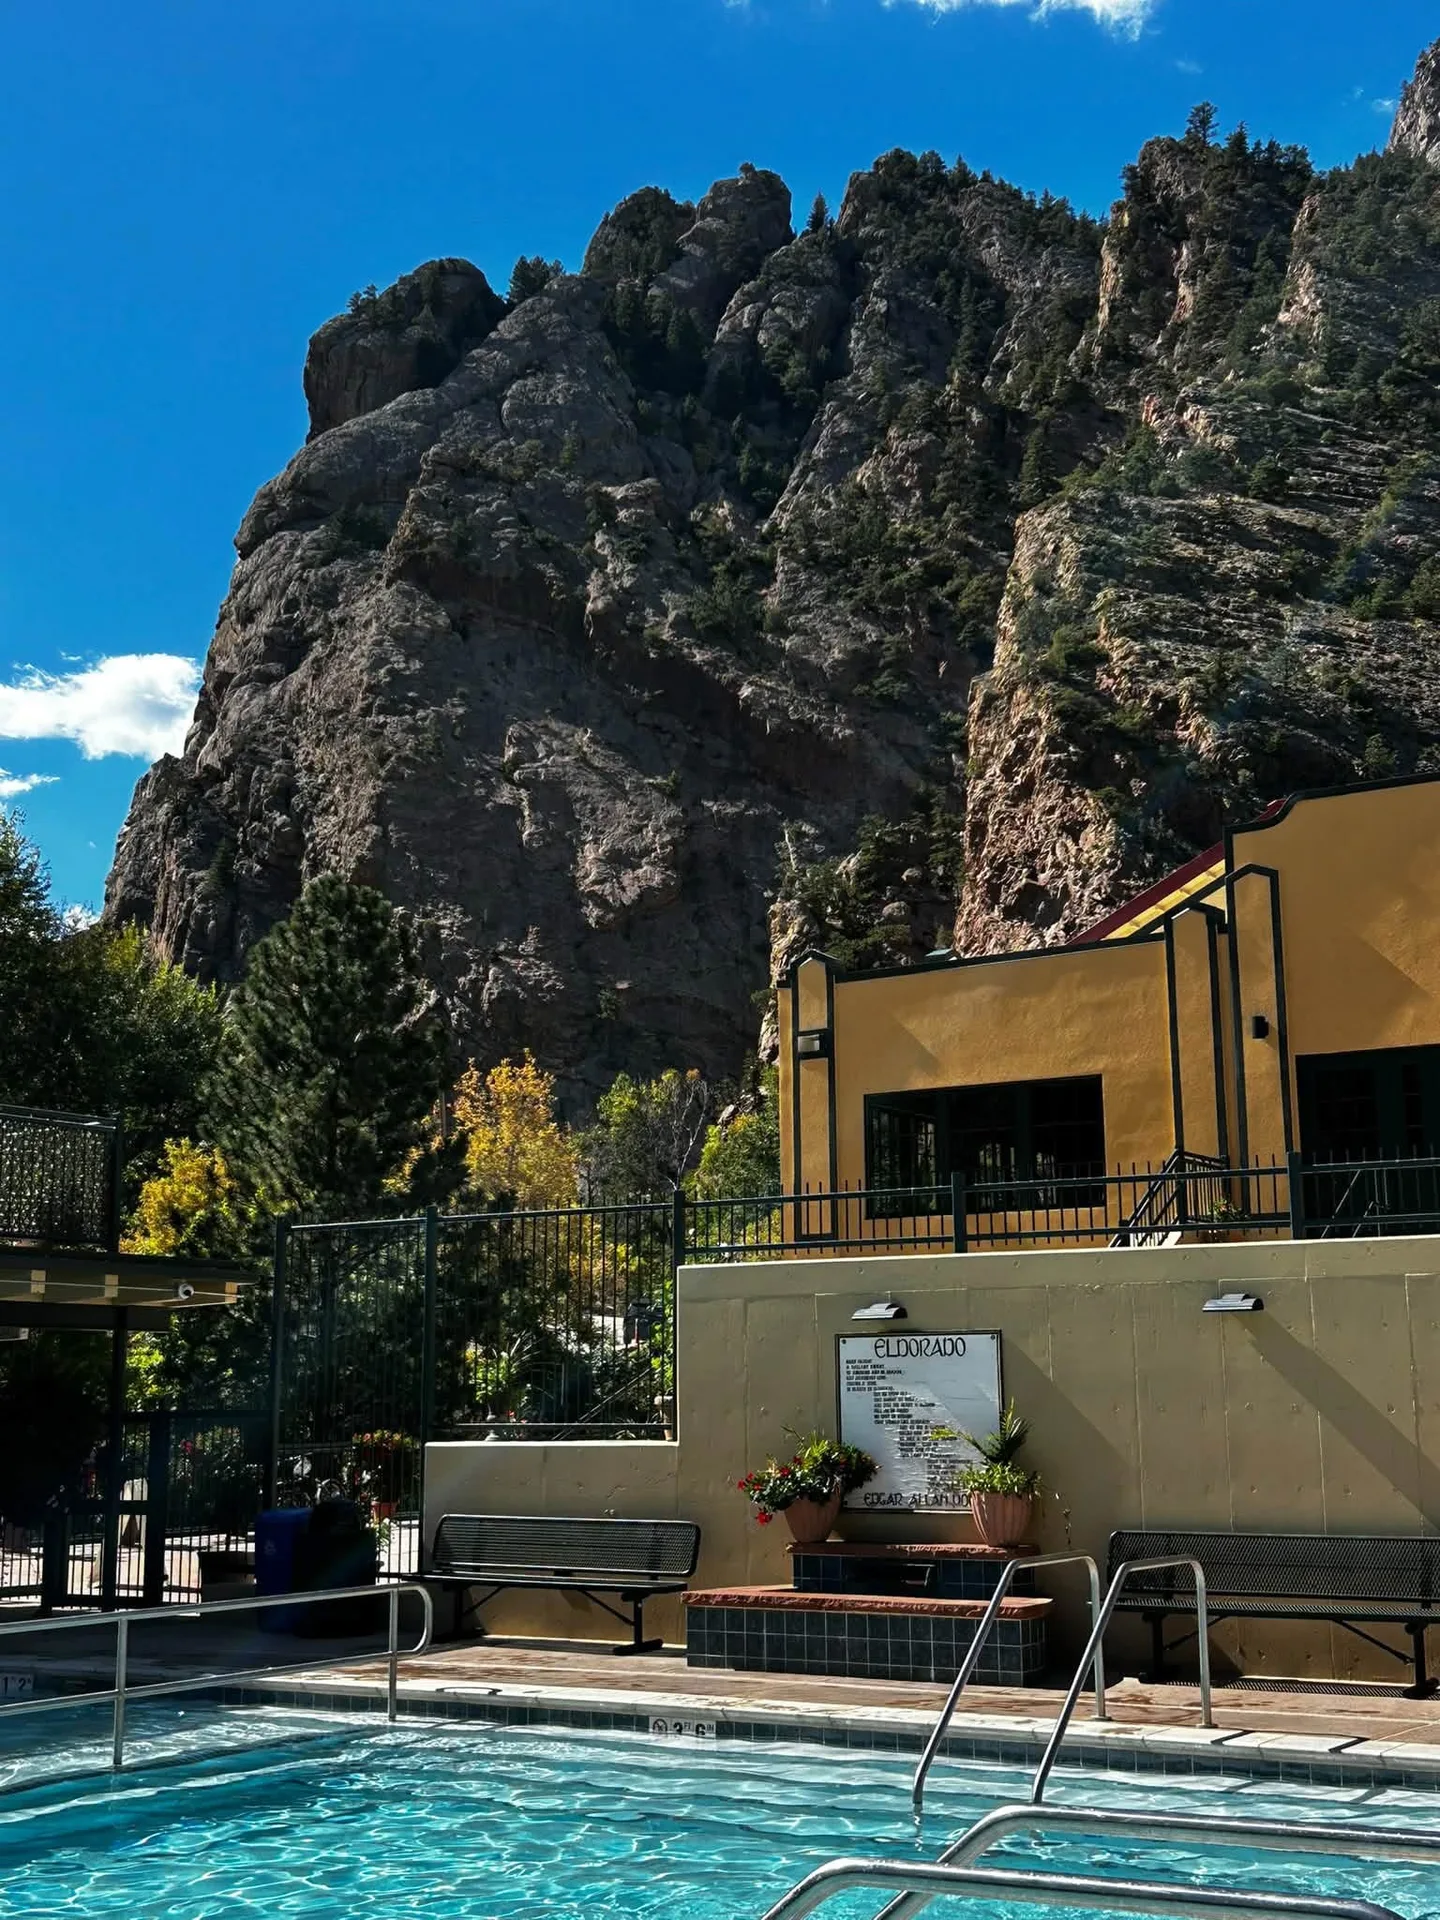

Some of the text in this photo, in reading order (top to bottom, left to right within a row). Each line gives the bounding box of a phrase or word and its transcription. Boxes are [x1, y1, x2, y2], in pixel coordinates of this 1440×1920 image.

[874, 1337, 966, 1358] ELDORADO
[863, 1492, 903, 1507] EDGAR
[695, 1723, 706, 1736] 6
